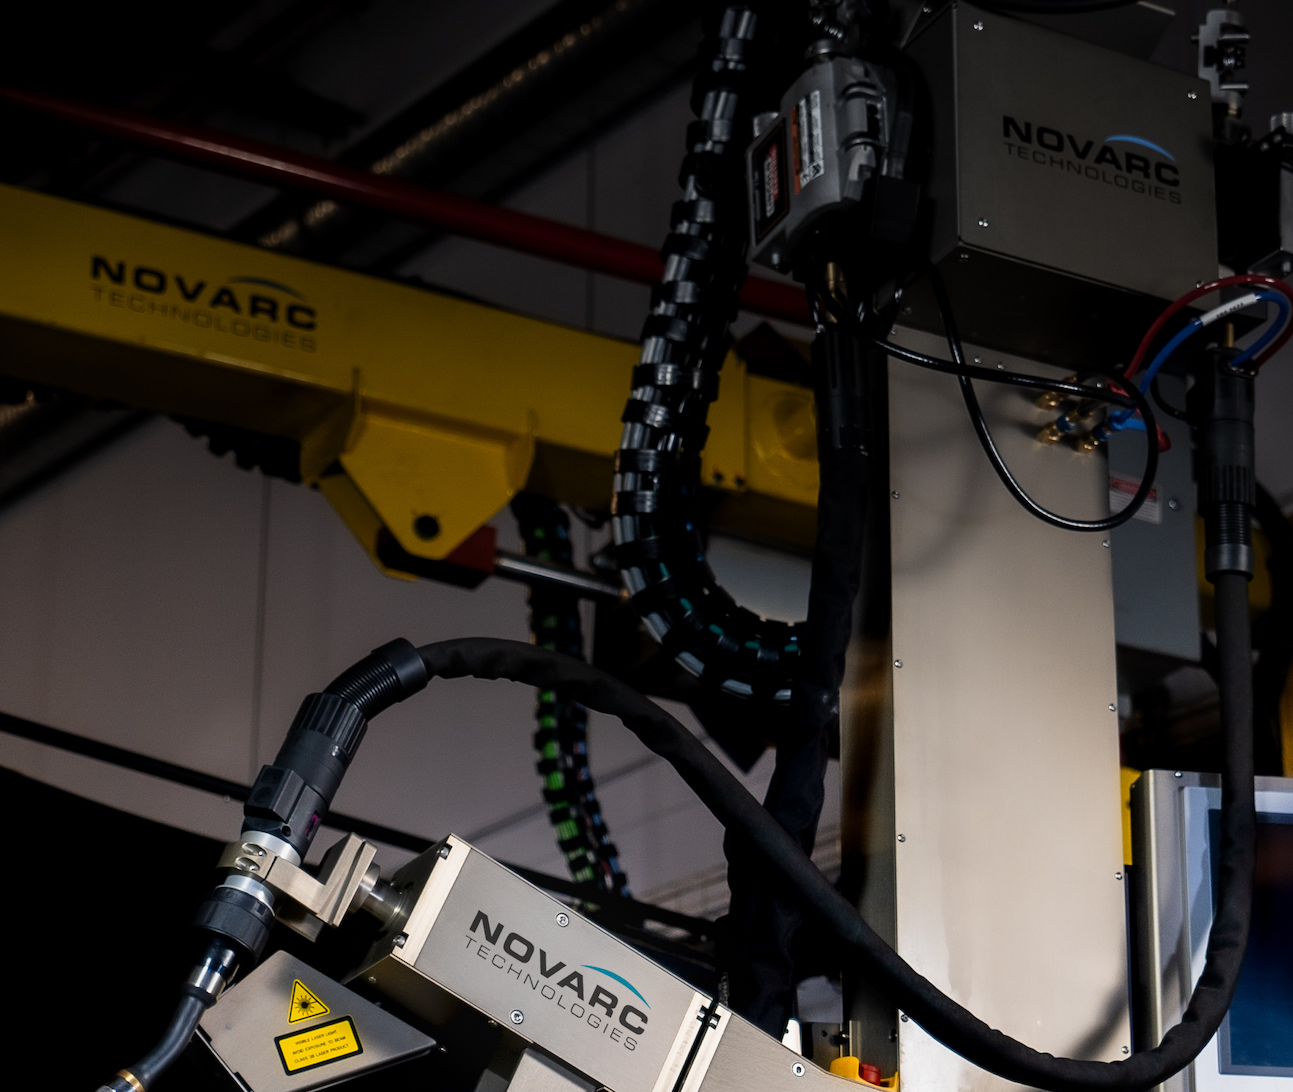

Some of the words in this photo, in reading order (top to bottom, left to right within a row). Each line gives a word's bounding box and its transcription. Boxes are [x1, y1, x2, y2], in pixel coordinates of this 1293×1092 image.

[1002, 115, 1180, 187] NOVARC
[1003, 142, 1182, 205] TECHNOLOGIES
[91, 256, 318, 330] NOVARC
[92, 286, 318, 352] TECHNOLOGIES
[465, 934, 638, 1052] TECHNOLOGIES
[469, 910, 649, 1035] NOVARC
